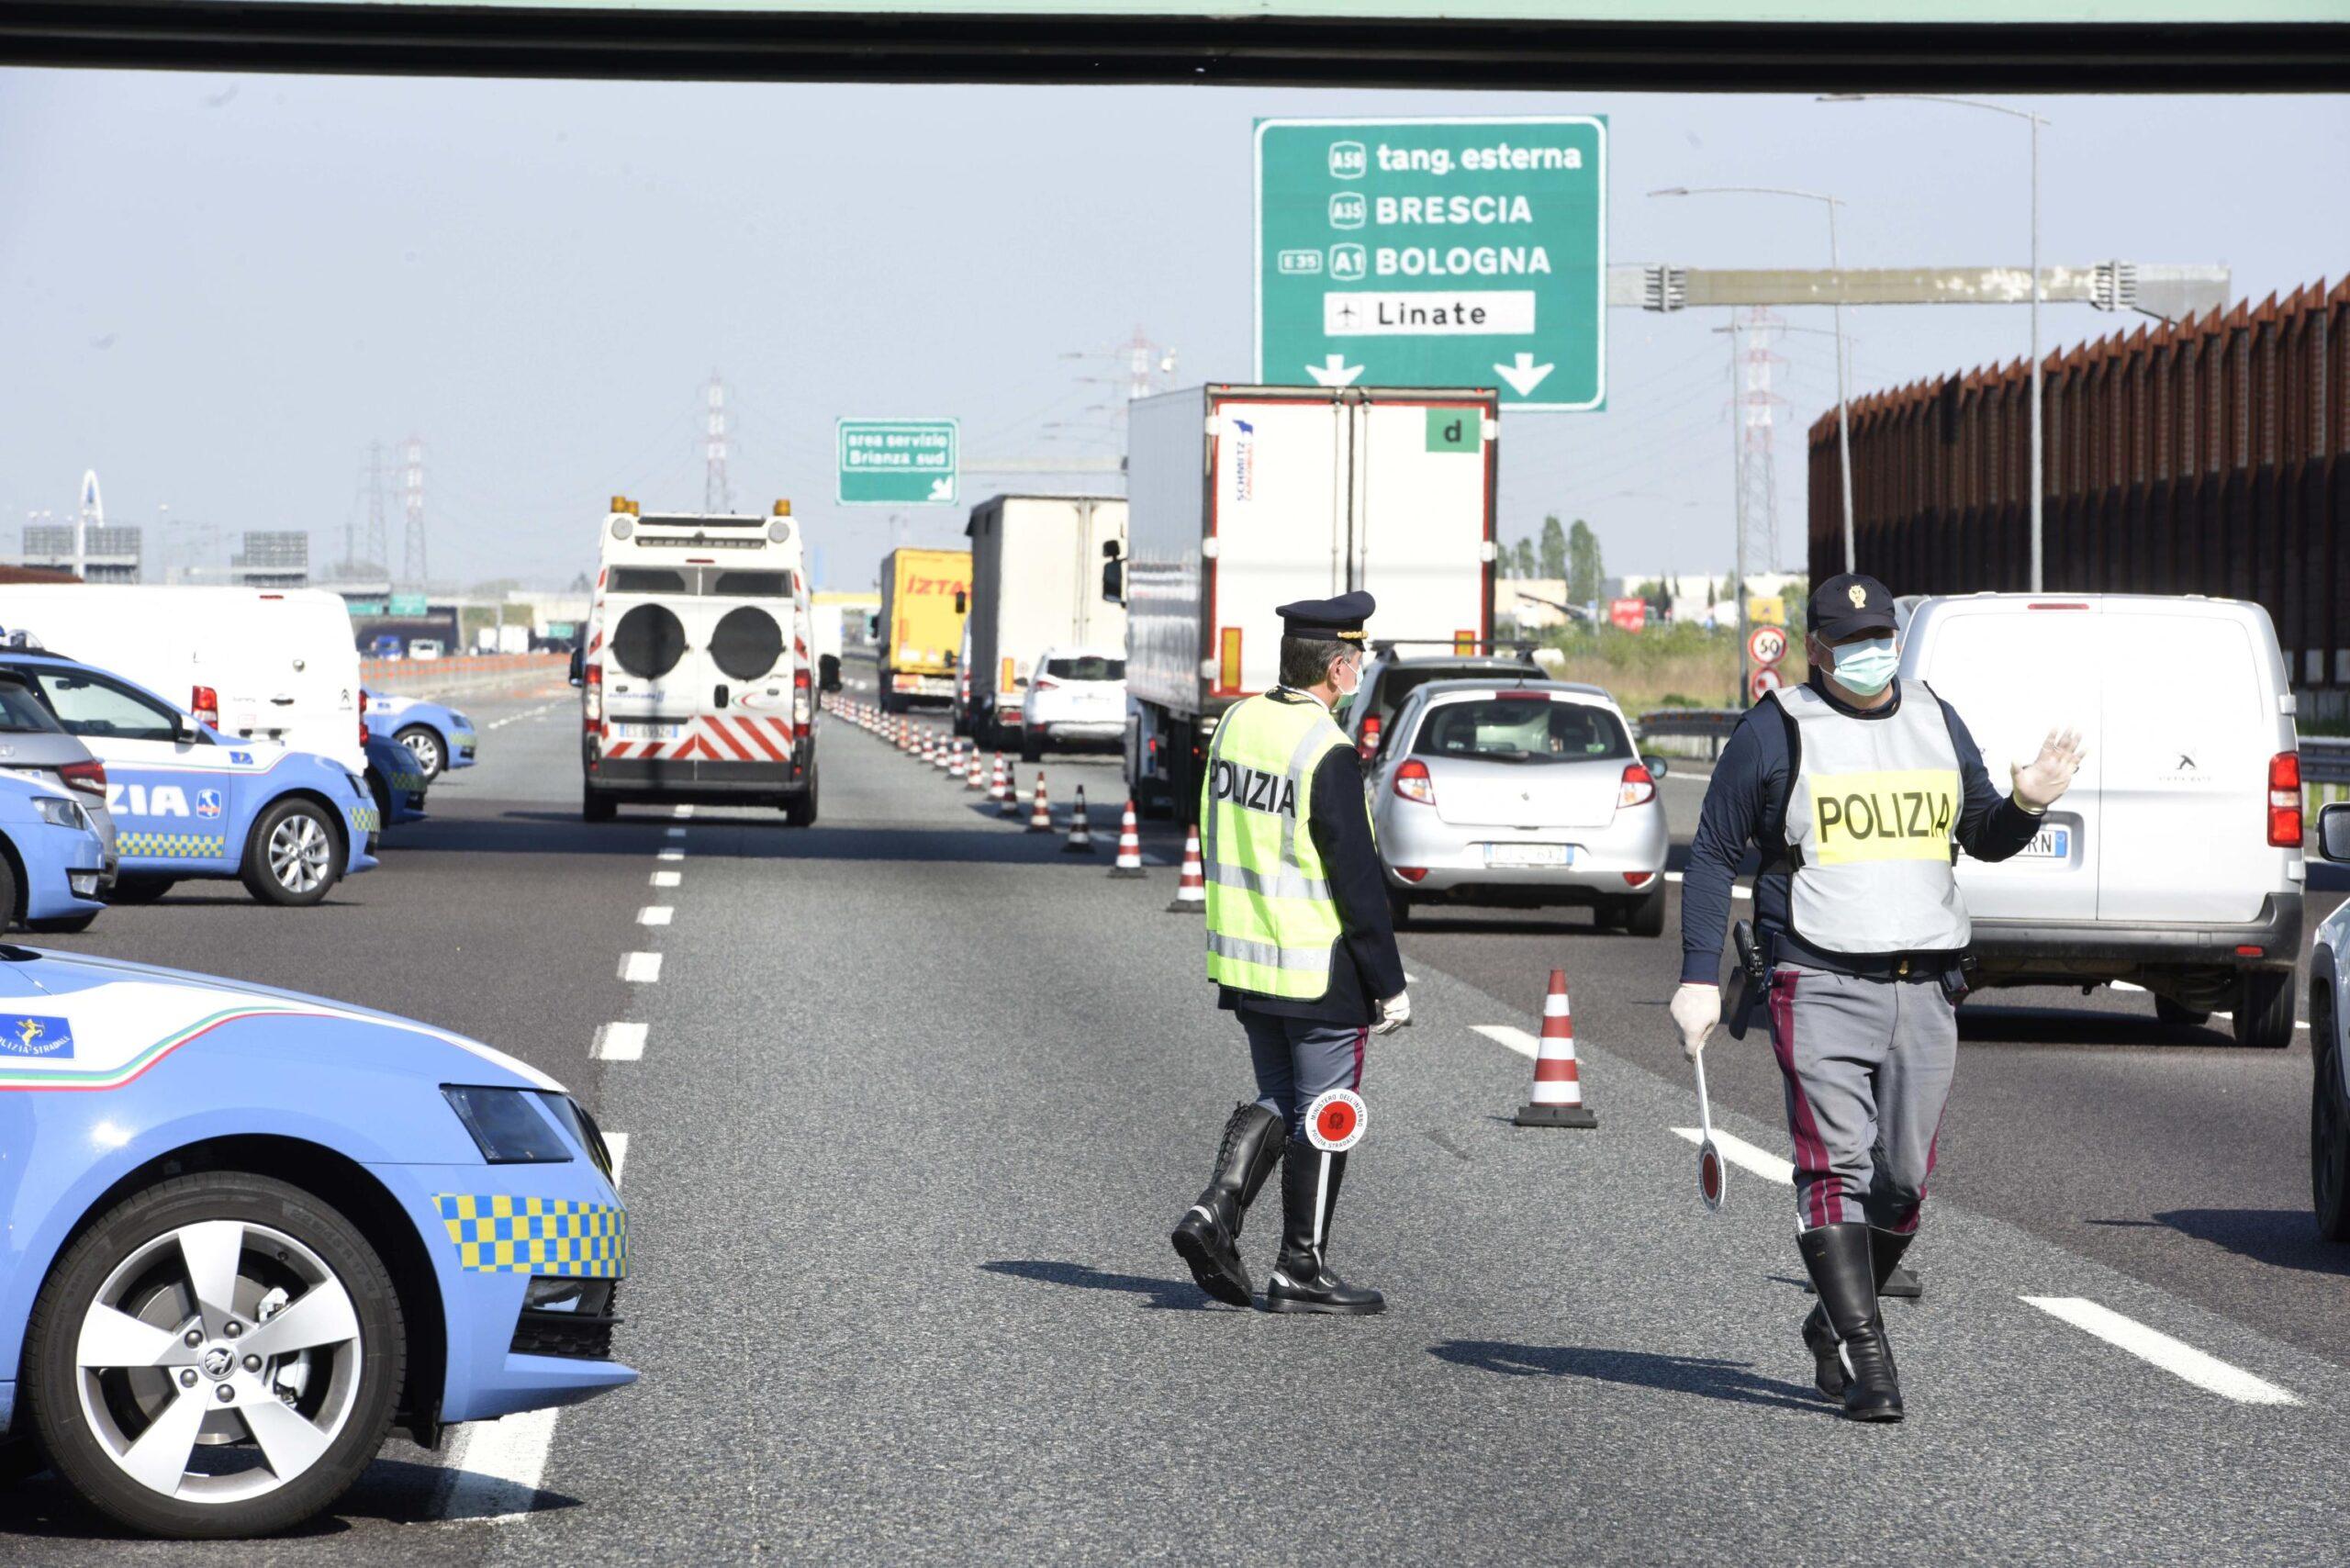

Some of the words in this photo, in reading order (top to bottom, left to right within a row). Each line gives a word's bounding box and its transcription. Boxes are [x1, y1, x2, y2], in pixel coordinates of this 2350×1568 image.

[1377, 142, 1456, 174] tang.
[1461, 142, 1583, 170] esterna
[1333, 202, 1362, 219] A35
[1376, 196, 1533, 224] BRESCIA
[1334, 251, 1362, 273] A1
[1375, 246, 1551, 275] BOLOGNA
[1378, 302, 1487, 326] Linate
[1444, 420, 1461, 443] d
[1760, 639, 1781, 655] 50
[1208, 758, 1296, 819] POLIZIA
[1817, 790, 1951, 844] POLIZIA
[1311, 1093, 1337, 1120] MINISTERO
[1312, 1129, 1326, 1147] POLIZIA
[1327, 1135, 1357, 1148] STRADALE
